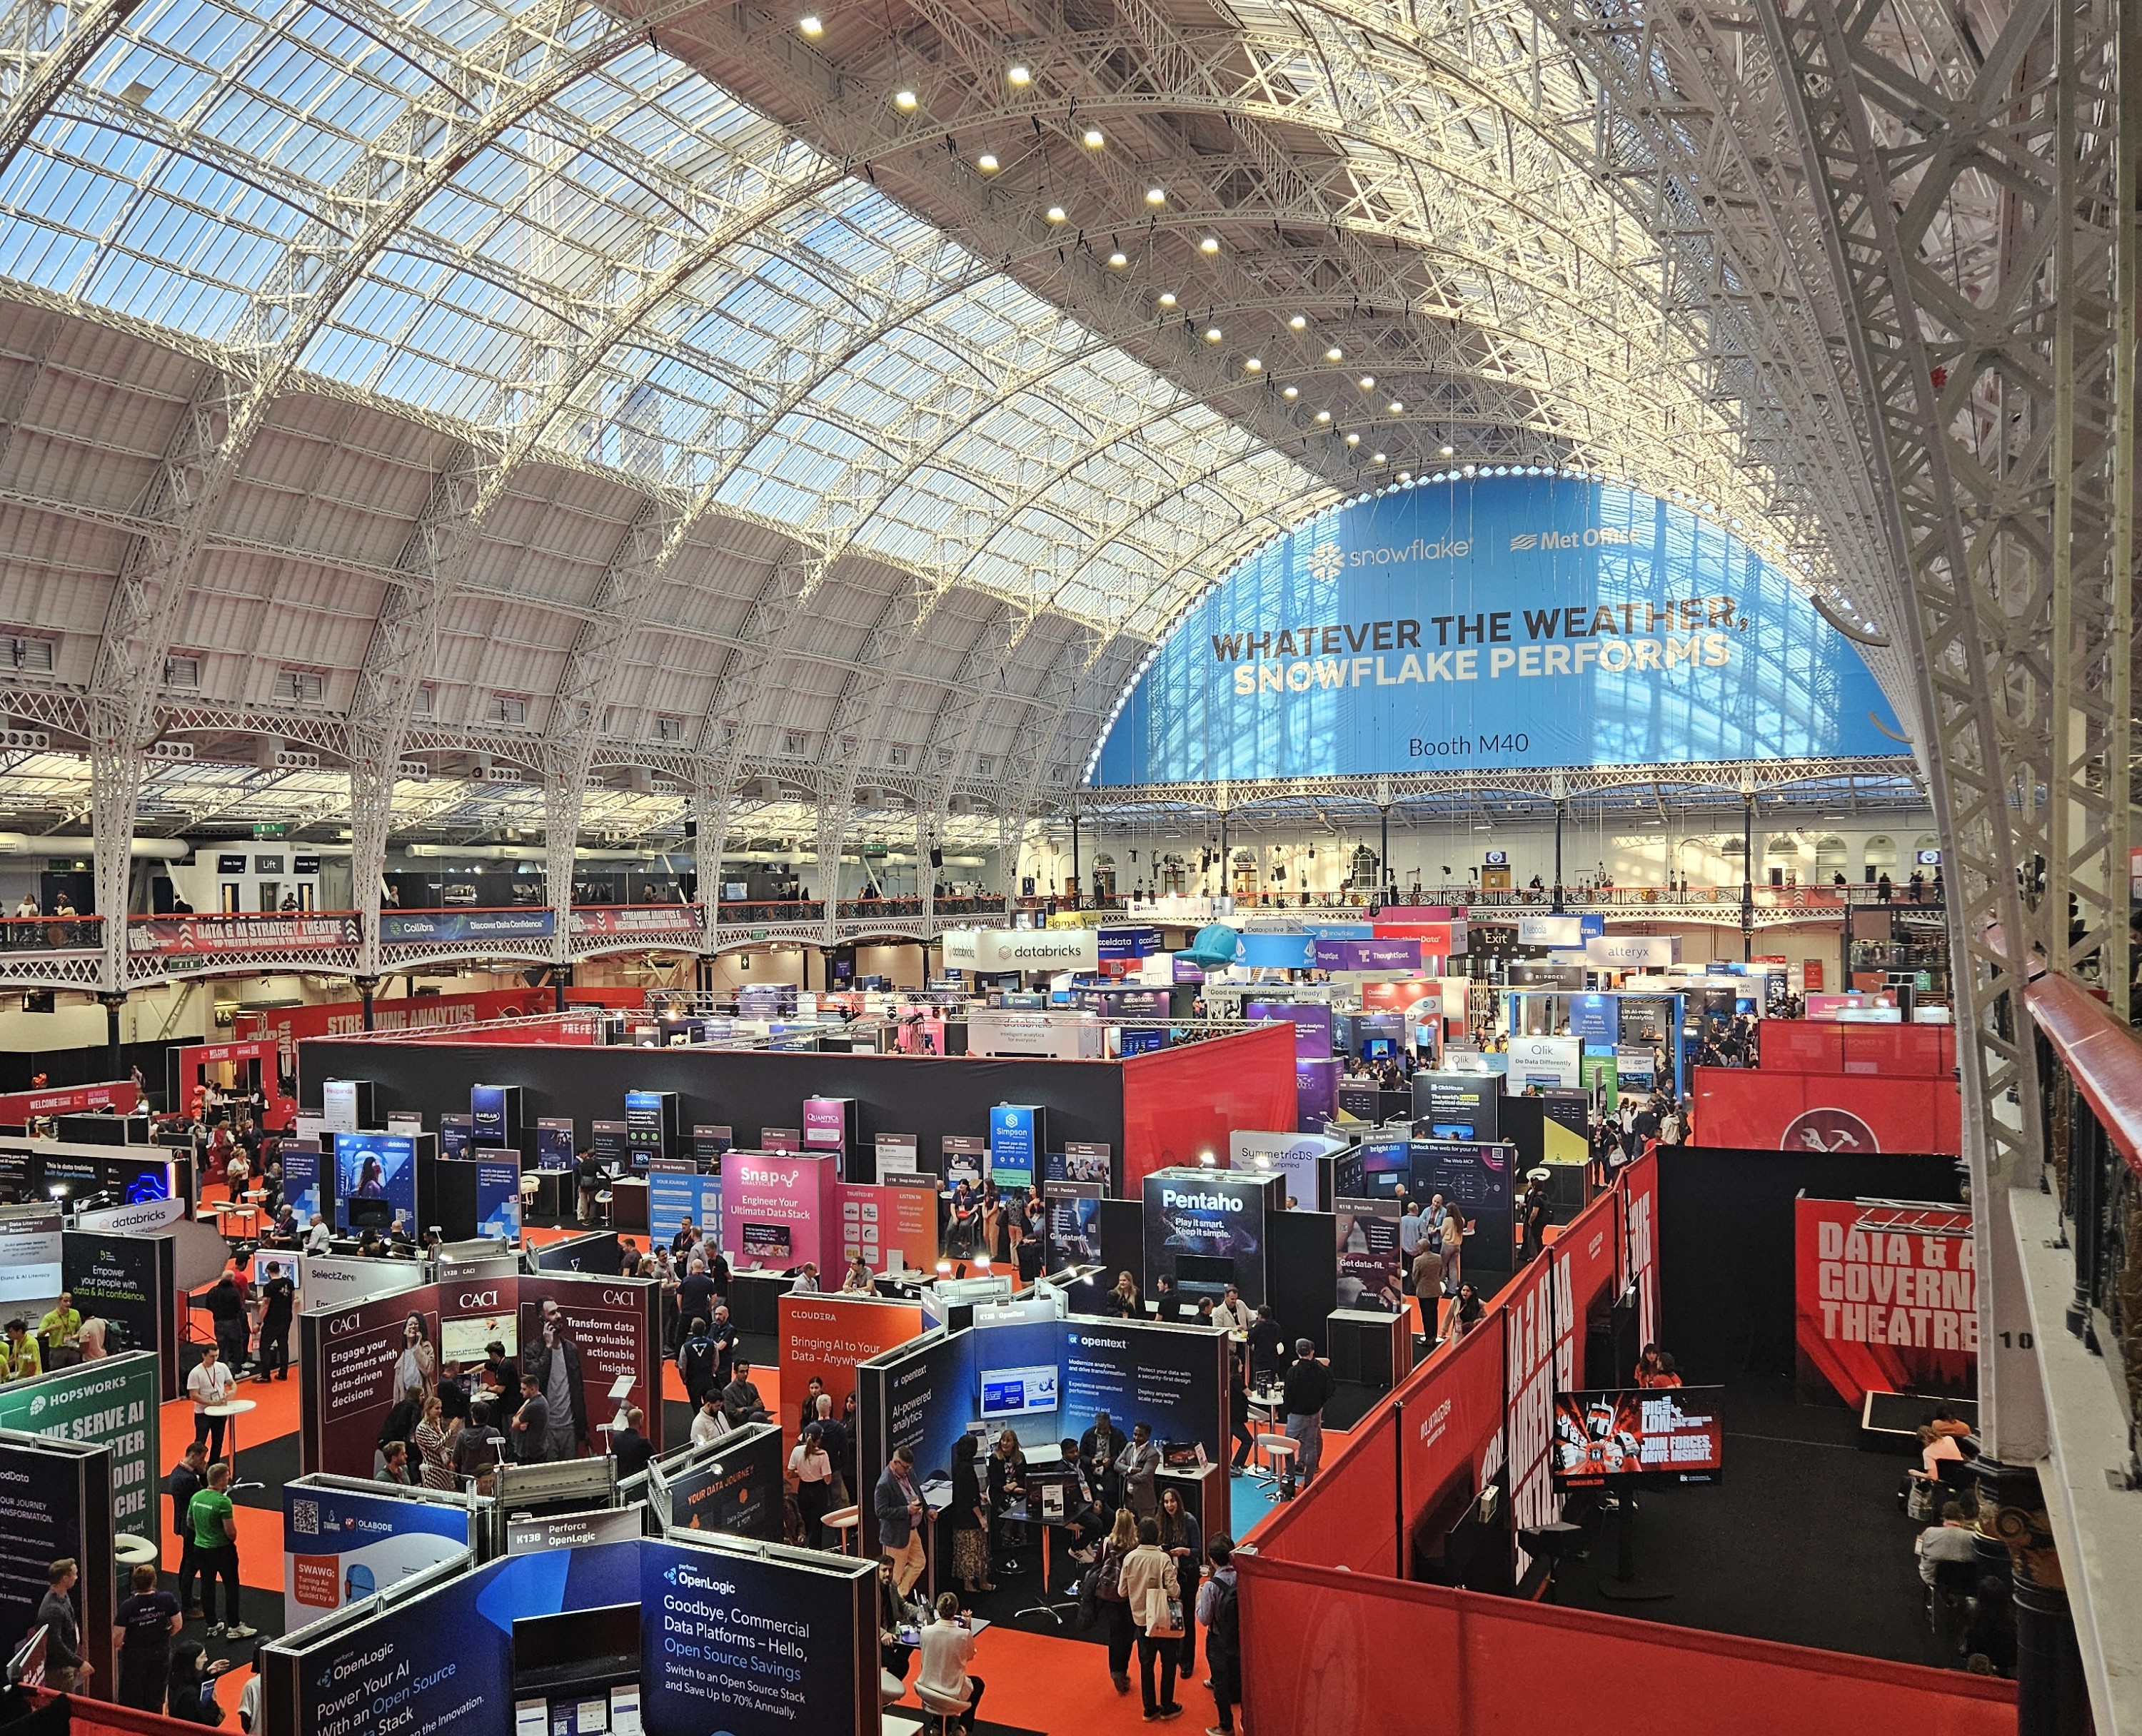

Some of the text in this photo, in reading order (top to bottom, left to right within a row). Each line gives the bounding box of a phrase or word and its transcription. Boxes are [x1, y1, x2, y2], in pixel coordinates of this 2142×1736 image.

[1541, 531, 1579, 550] Met
[1349, 537, 1468, 567] snowflake
[1212, 597, 1749, 662] WHATEVER THE WEATHER,
[1234, 634, 1731, 695] SNOWFLAKE PERFORMS
[1409, 733, 1529, 757] Booth M40
[263, 860, 276, 869] Lift
[196, 923, 224, 939] DATA
[236, 922, 247, 937] AI
[248, 922, 299, 937] STRATEGY
[301, 920, 342, 935] THEATRE
[404, 922, 434, 933] Collibra
[1047, 919, 1076, 929] sigma
[1485, 932, 1507, 944] Exit
[1015, 944, 1082, 958] databricks
[1373, 951, 1409, 960] ThoughtSpot.
[1608, 947, 1649, 958] alteryx
[1532, 1044, 1554, 1056] Qlik
[1452, 1055, 1469, 1065] Qlik
[326, 1087, 353, 1096] Redpanda
[30, 1098, 58, 1109] WELCOME
[997, 1128, 1027, 1138] Simpson
[1242, 1147, 1313, 1161] SymmetricDS
[1369, 1145, 1388, 1154] bright
[741, 1168, 778, 1186] Snap
[743, 1195, 798, 1207] Engineer Your
[1162, 1189, 1243, 1212] Pentaho
[112, 1210, 166, 1228] databricks
[731, 1206, 810, 1220] Ultimate Data Stack
[1175, 1217, 1225, 1228] Play it smart.
[1175, 1227, 1231, 1238] Keep it simple.
[93, 1265, 125, 1278] Empower
[1339, 1258, 1384, 1270] Get data-fit.
[81, 1276, 137, 1290] your people with
[73, 1285, 146, 1302] data & AI confidence.
[459, 1290, 498, 1308] CACI
[603, 1289, 634, 1306] CACI
[330, 1312, 360, 1335] CACI
[567, 1316, 635, 1333] Transform data
[791, 1311, 836, 1322] CLOUDERA
[1819, 1300, 1977, 1353] THEATRE
[575, 1331, 635, 1346] into valuable
[791, 1336, 880, 1354] Bringing AI to Your
[1081, 1336, 1127, 1349] opentext
[1998, 1331, 2034, 1350] 10
[331, 1338, 387, 1363] Engage your
[586, 1346, 635, 1361] actionable
[331, 1348, 398, 1378] customers with
[600, 1361, 635, 1375] insights
[331, 1368, 383, 1393] data-driven
[901, 1365, 927, 1385] opentext
[50, 1375, 127, 1406] HOPSWORKS
[332, 1386, 373, 1408] decisions
[893, 1388, 932, 1418] AI-powered
[1642, 1401, 1662, 1415] BIG
[1641, 1435, 1712, 1450] JOIN FORCES.
[1641, 1448, 1712, 1463] DRIVE INSIGHT.
[688, 1464, 755, 1506] YOUR DATA JOURNEY
[358, 1519, 393, 1532] OLABODE
[548, 1522, 587, 1533] Perforce
[548, 1533, 595, 1547] OpenLogic
[298, 1564, 335, 1578] SWAWG:
[678, 1571, 735, 1594] OpenLogic
[298, 1591, 319, 1600] Guided
[320, 1593, 328, 1601] by
[663, 1595, 810, 1640] Goodbye, Commercial
[664, 1615, 694, 1636] Data
[696, 1625, 755, 1649] Platforms
[769, 1640, 808, 1662] Hello,
[333, 1642, 395, 1680] OpenLogic
[664, 1637, 802, 1682] Open Source Savings
[317, 1660, 410, 1721] Power Your AI
[665, 1662, 806, 1705] Switch to an Open Source Stack
[353, 1709, 370, 1725] an
[373, 1690, 410, 1715] Open
[413, 1662, 457, 1695] Source
[378, 1707, 414, 1736] Stack
[421, 1696, 485, 1736] the Innovation.
